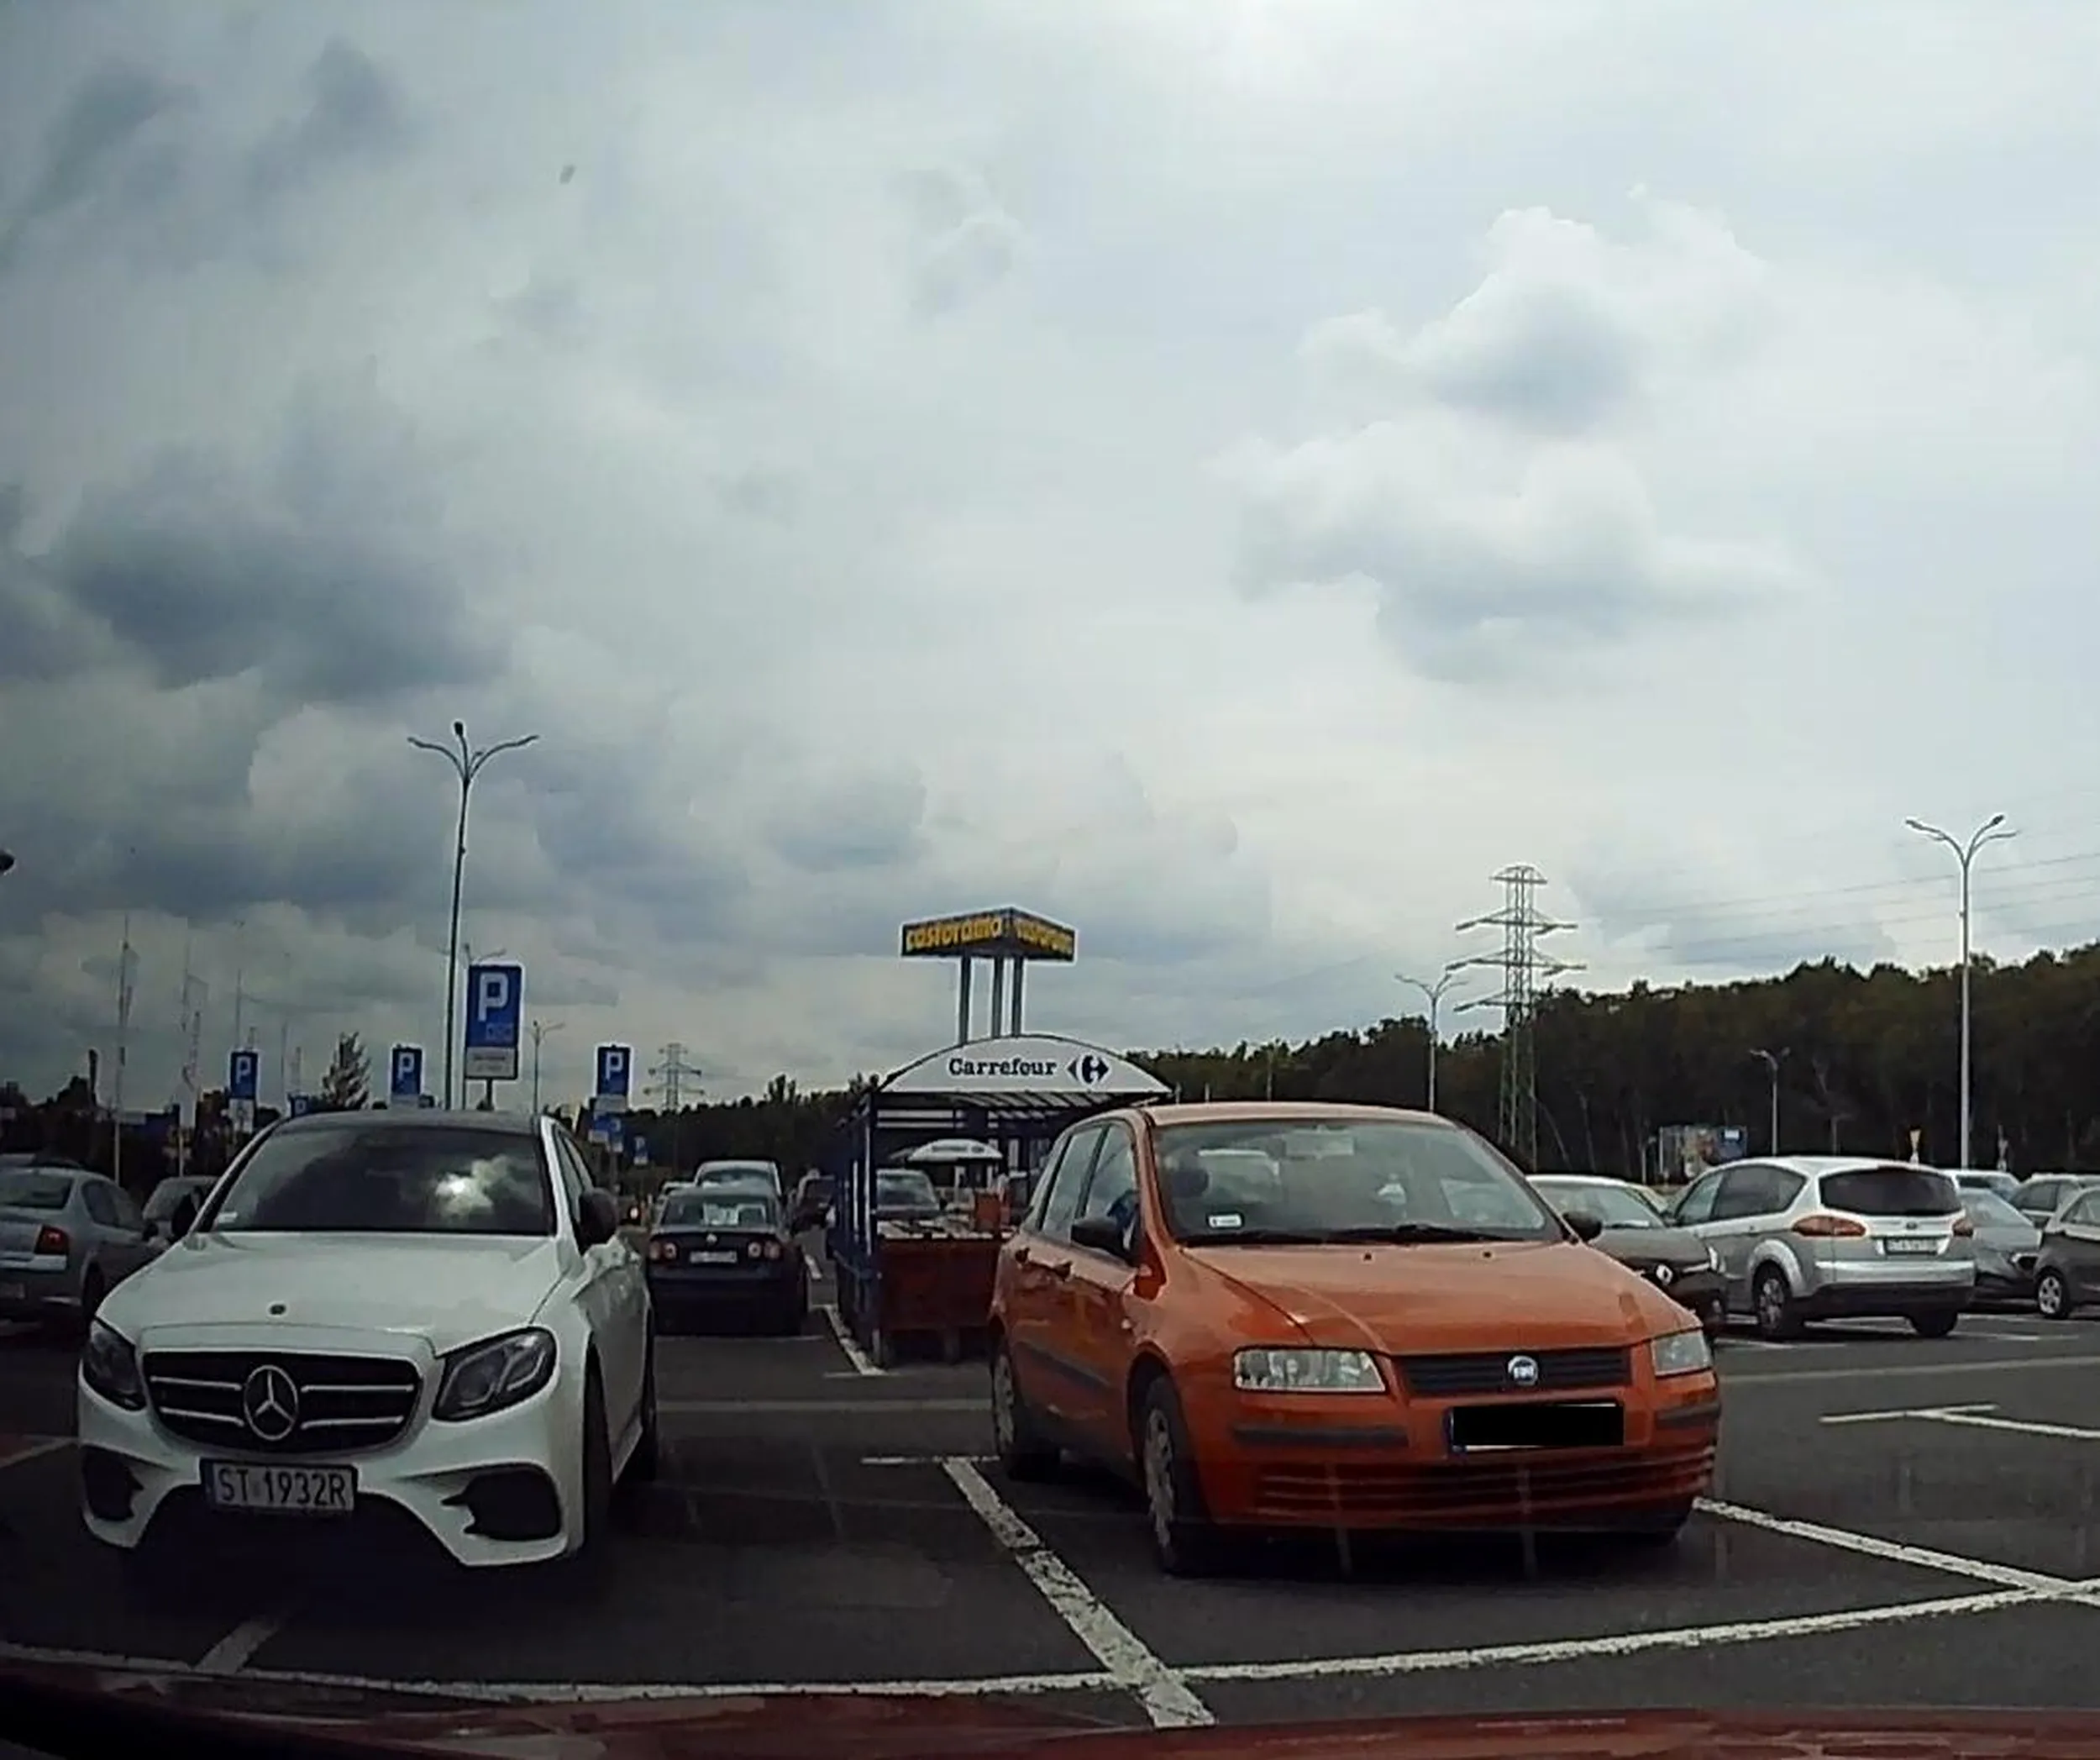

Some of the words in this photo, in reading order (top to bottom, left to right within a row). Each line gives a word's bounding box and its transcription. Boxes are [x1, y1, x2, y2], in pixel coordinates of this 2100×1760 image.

[906, 916, 1003, 952] castorama
[478, 972, 508, 1022] P
[236, 1056, 251, 1085] P
[398, 1052, 415, 1080] P
[605, 1052, 623, 1080] P
[948, 1057, 1057, 1076] Carrefour
[218, 1467, 249, 1502] ST
[264, 1469, 346, 1506] 1932R
